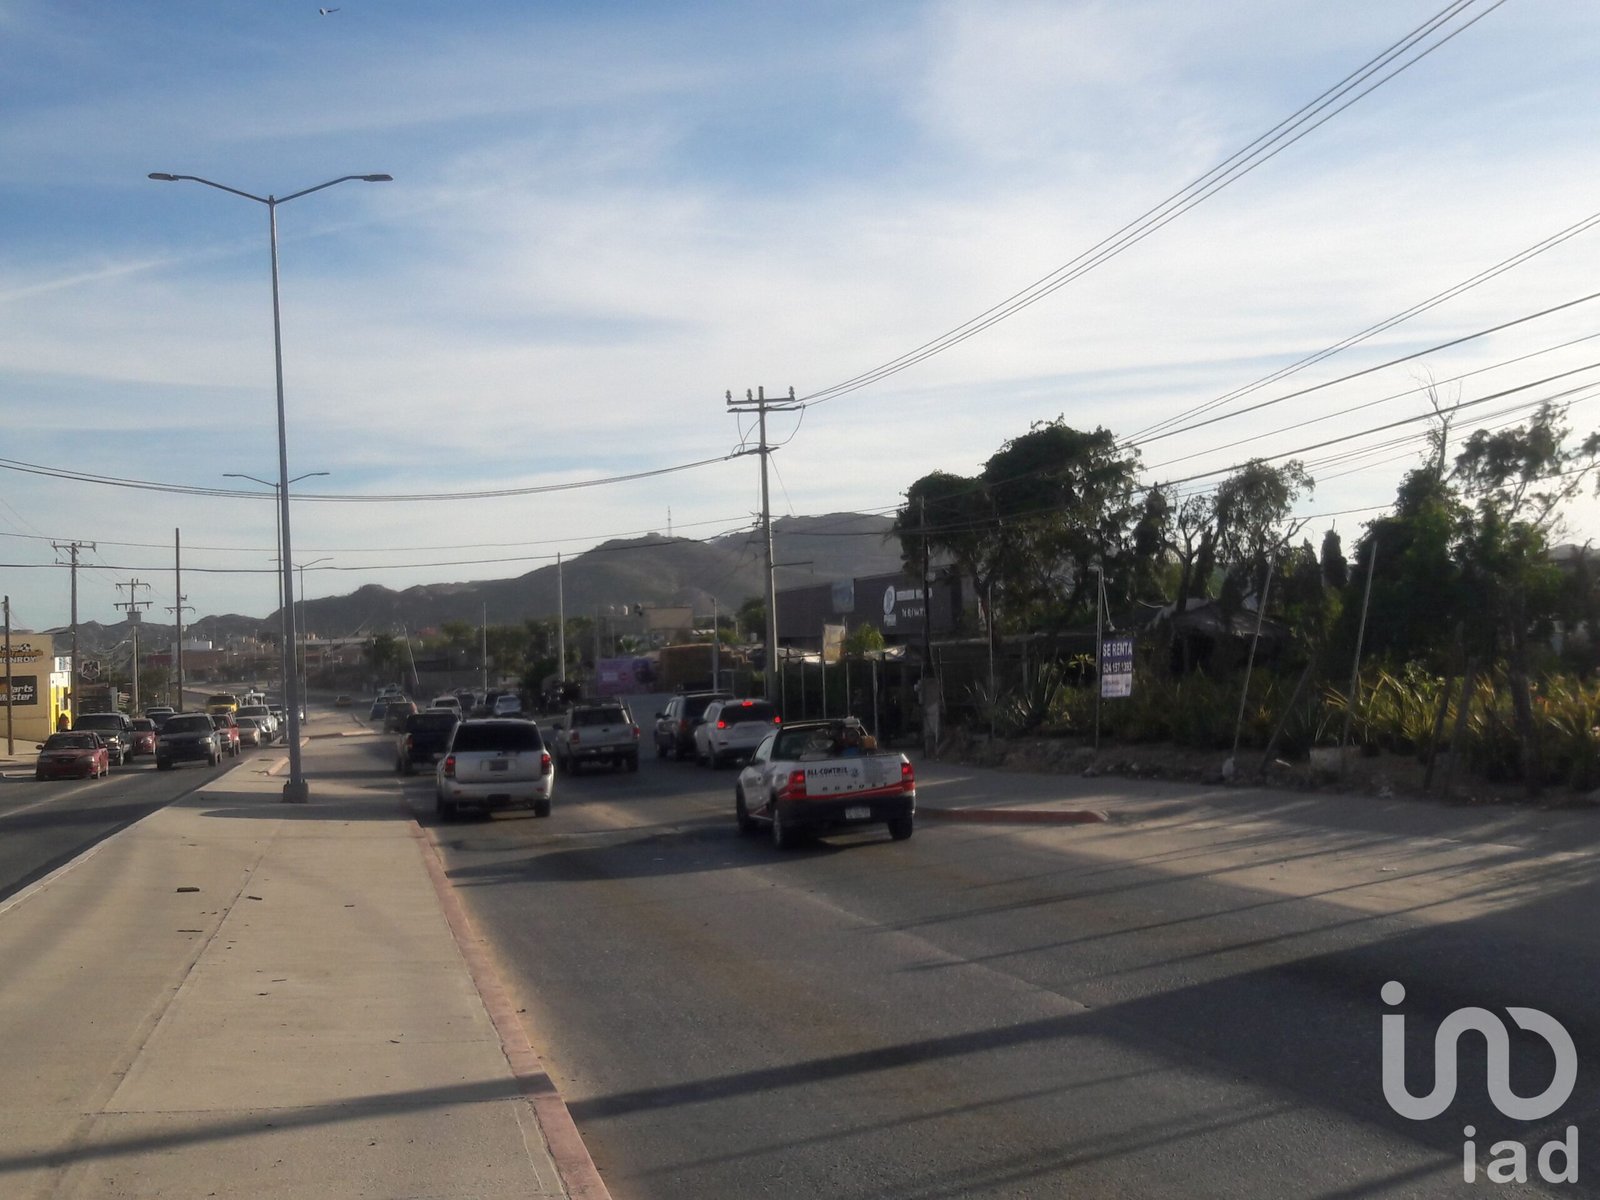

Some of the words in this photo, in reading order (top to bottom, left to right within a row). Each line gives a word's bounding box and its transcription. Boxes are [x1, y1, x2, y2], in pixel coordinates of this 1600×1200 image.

[1103, 643, 1111, 657] SE
[1112, 642, 1133, 656] RENTA
[10, 684, 34, 693] arts
[0, 693, 33, 702] Mster
